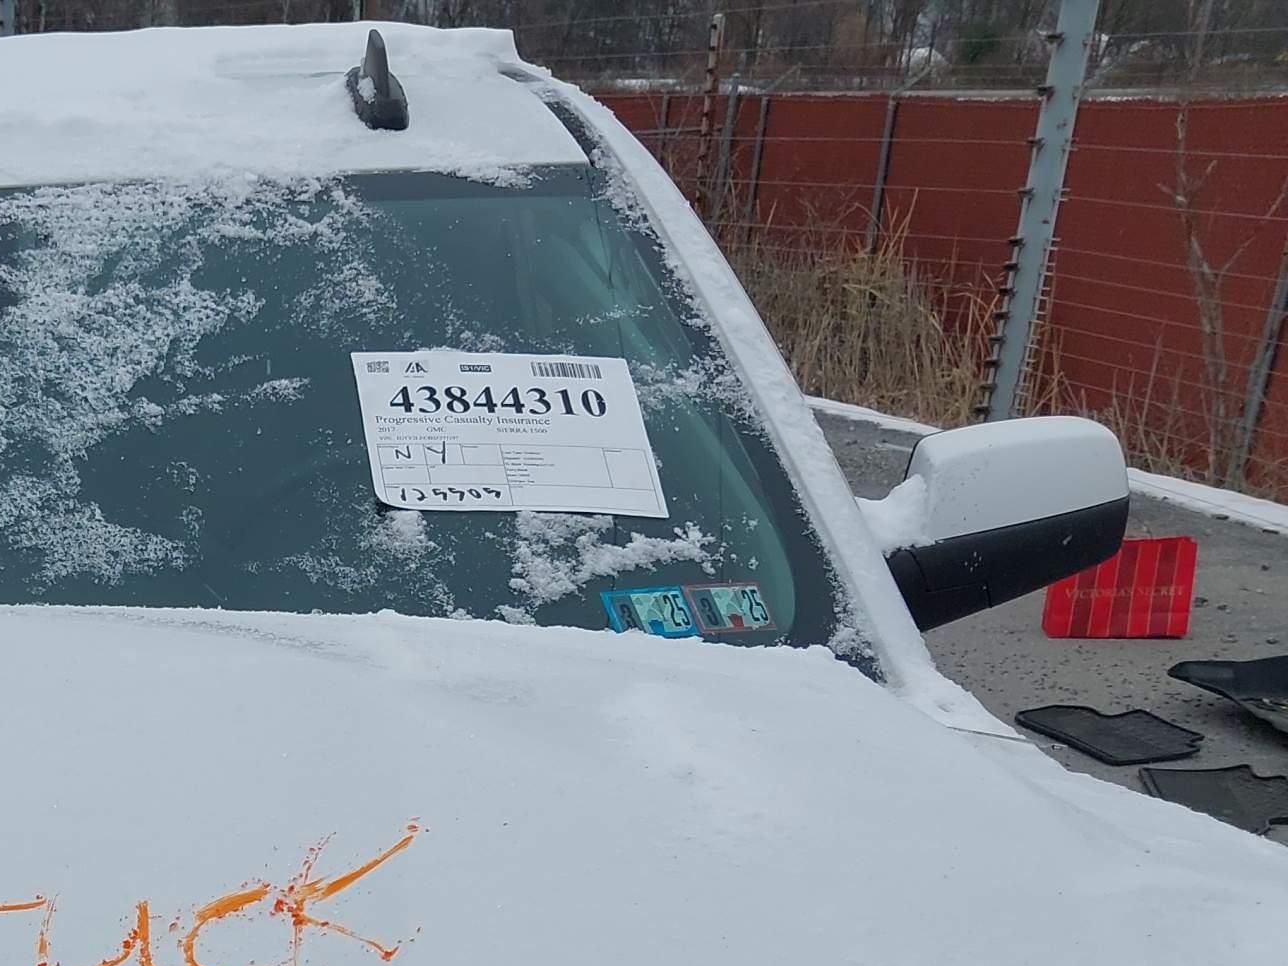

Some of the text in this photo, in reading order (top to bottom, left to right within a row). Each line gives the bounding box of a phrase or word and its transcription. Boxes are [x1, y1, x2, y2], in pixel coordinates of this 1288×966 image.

[390, 385, 607, 418] 43844310
[376, 415, 551, 426] Progressive Casualty Insurance
[741, 588, 769, 622] 25
[1137, 585, 1184, 597] SECRET
[664, 593, 691, 628] 25
